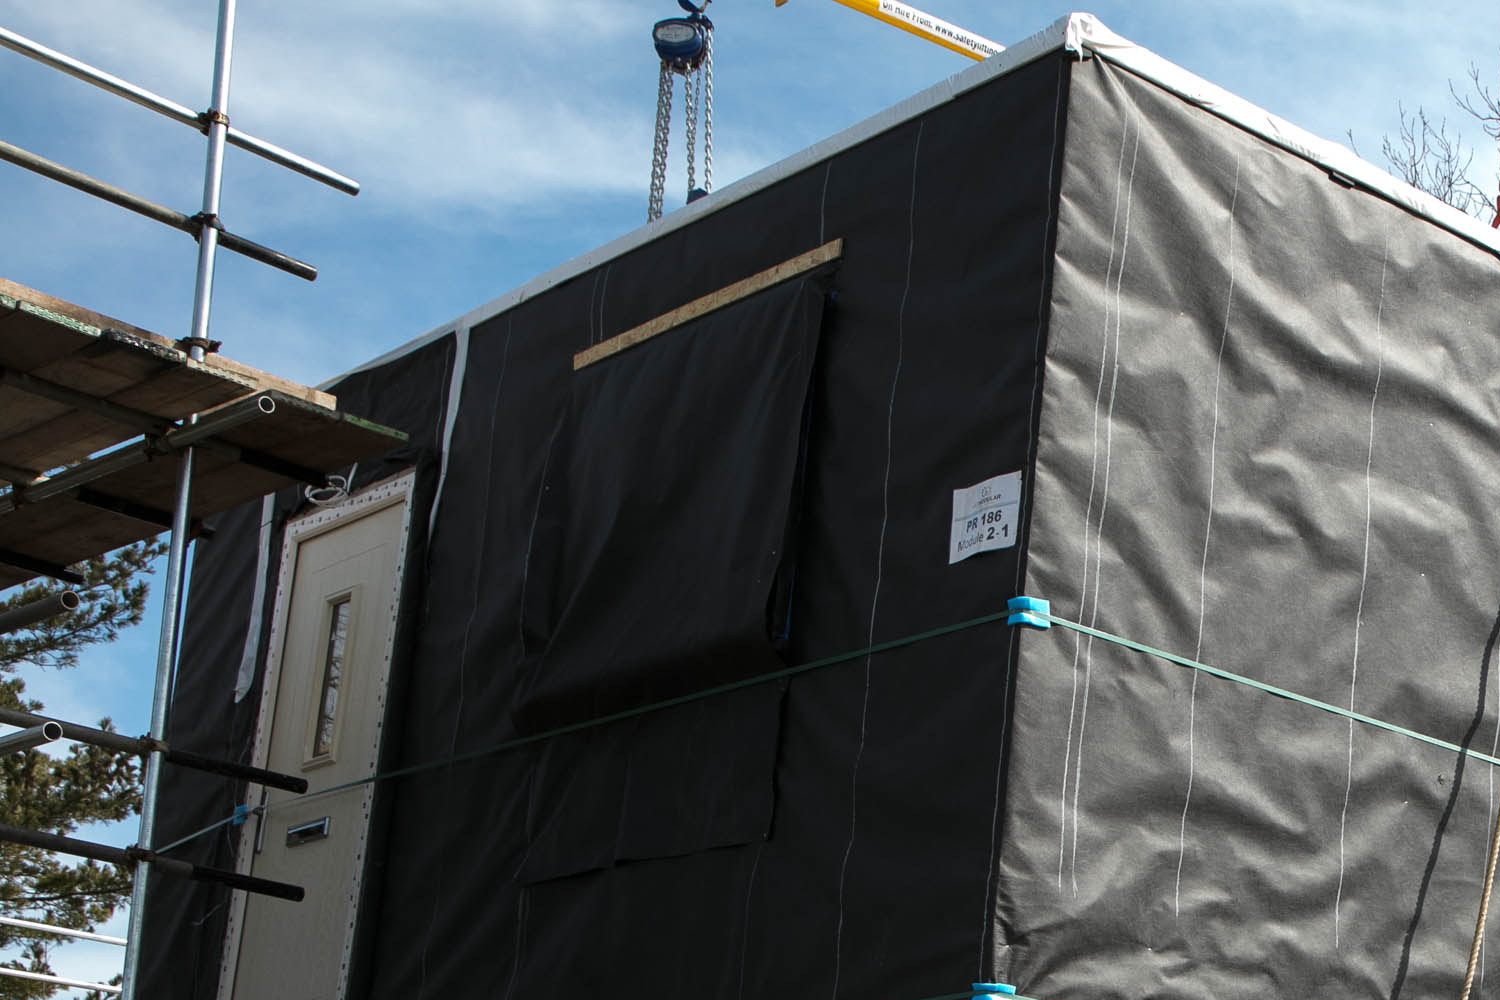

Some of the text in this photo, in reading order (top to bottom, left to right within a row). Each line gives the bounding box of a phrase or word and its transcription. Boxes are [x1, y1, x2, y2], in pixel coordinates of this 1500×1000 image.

[966, 510, 1002, 533] PR 186
[958, 532, 984, 552] Module
